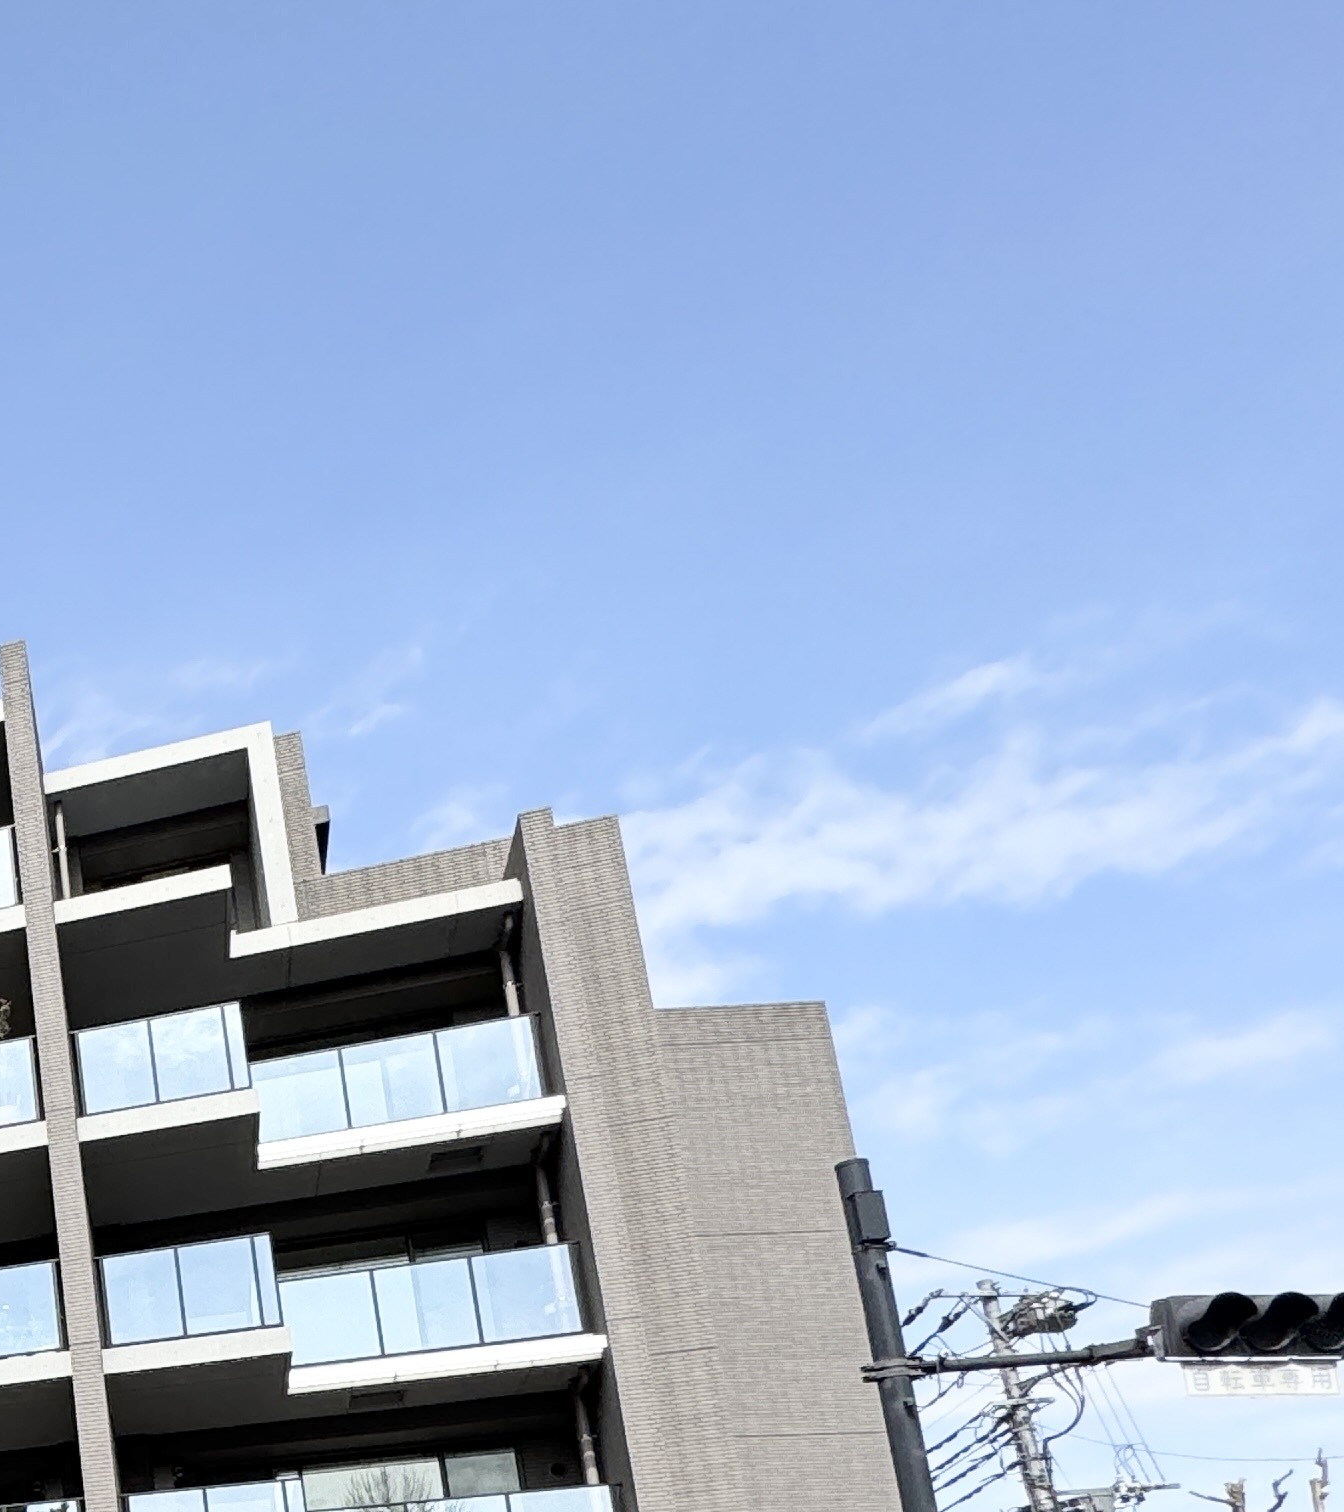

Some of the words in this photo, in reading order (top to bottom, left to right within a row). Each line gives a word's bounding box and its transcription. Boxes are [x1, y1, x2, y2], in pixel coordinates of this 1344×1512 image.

[1192, 1368, 1333, 1392] 自転車専用
